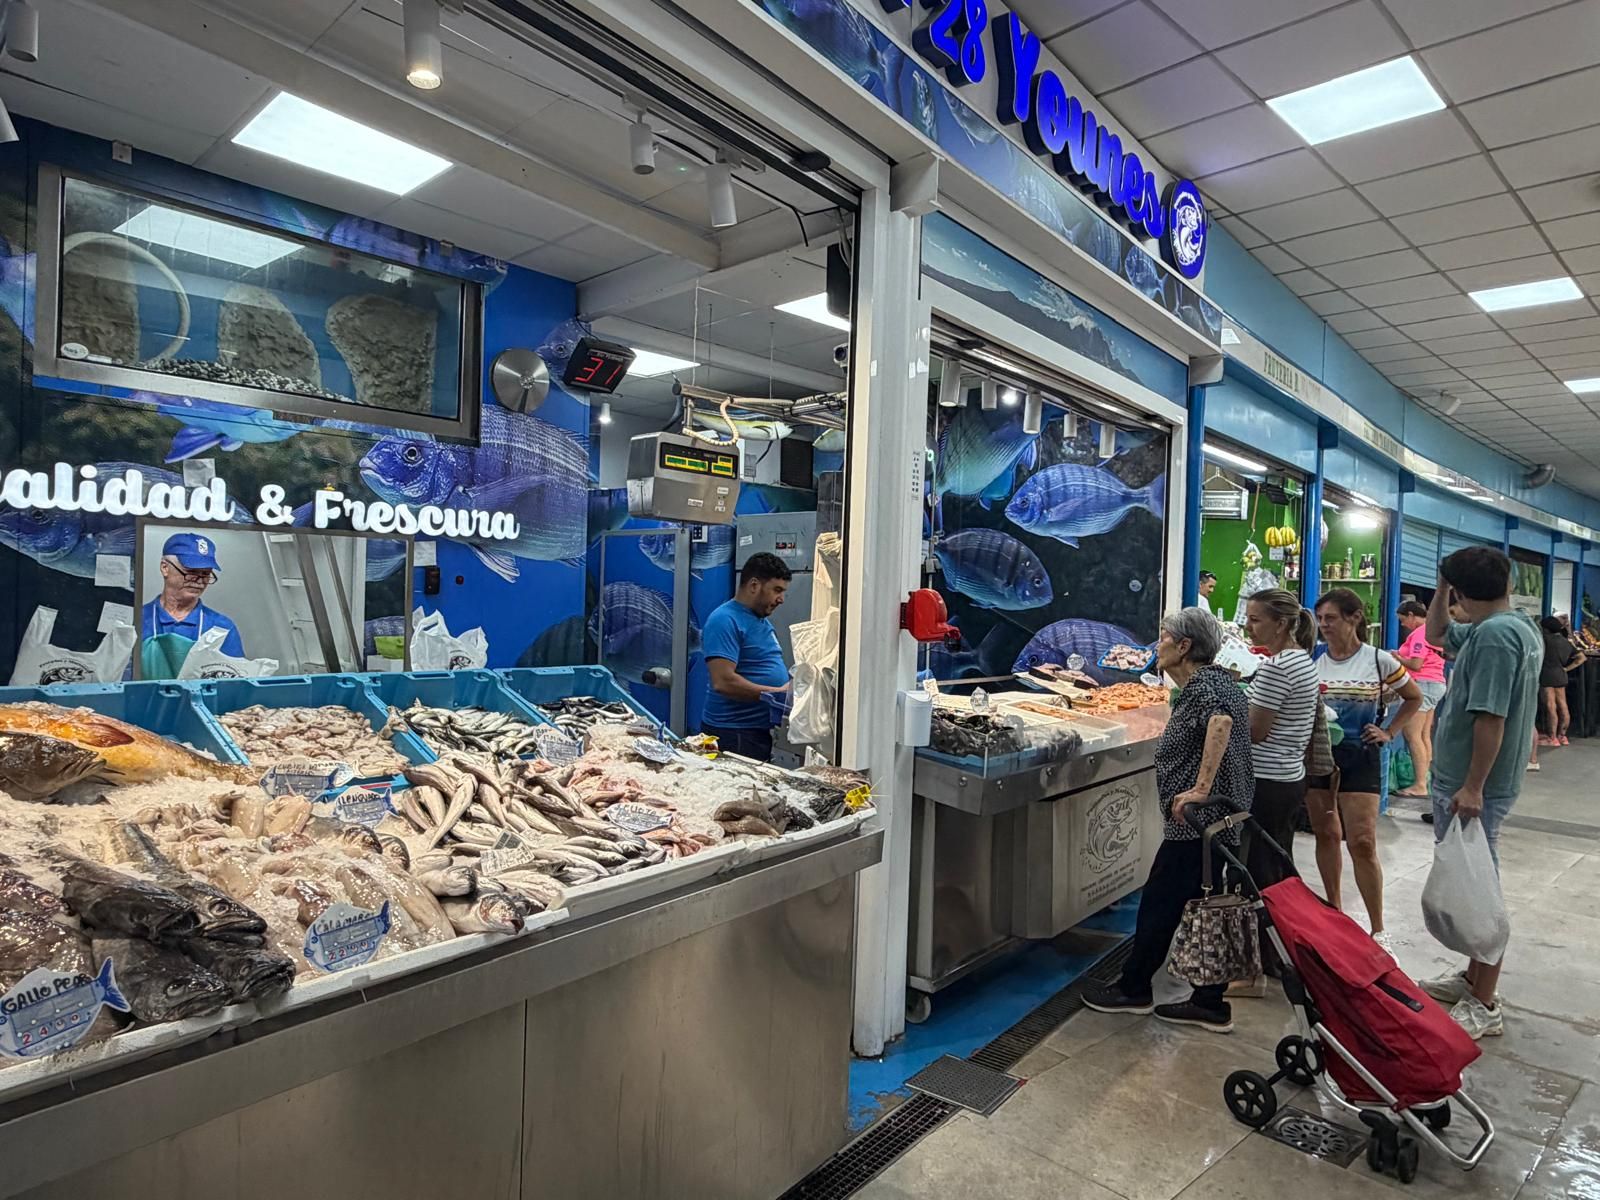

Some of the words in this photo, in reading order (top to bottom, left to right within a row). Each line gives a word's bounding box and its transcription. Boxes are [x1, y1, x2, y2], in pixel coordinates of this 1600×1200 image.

[929, 0, 985, 84] 28
[1006, 10, 1166, 241] Younes
[574, 356, 624, 385] 31
[0, 461, 236, 522] alidad
[256, 484, 297, 526] &
[314, 489, 521, 540] Frescura
[1, 985, 52, 1015] GALLO
